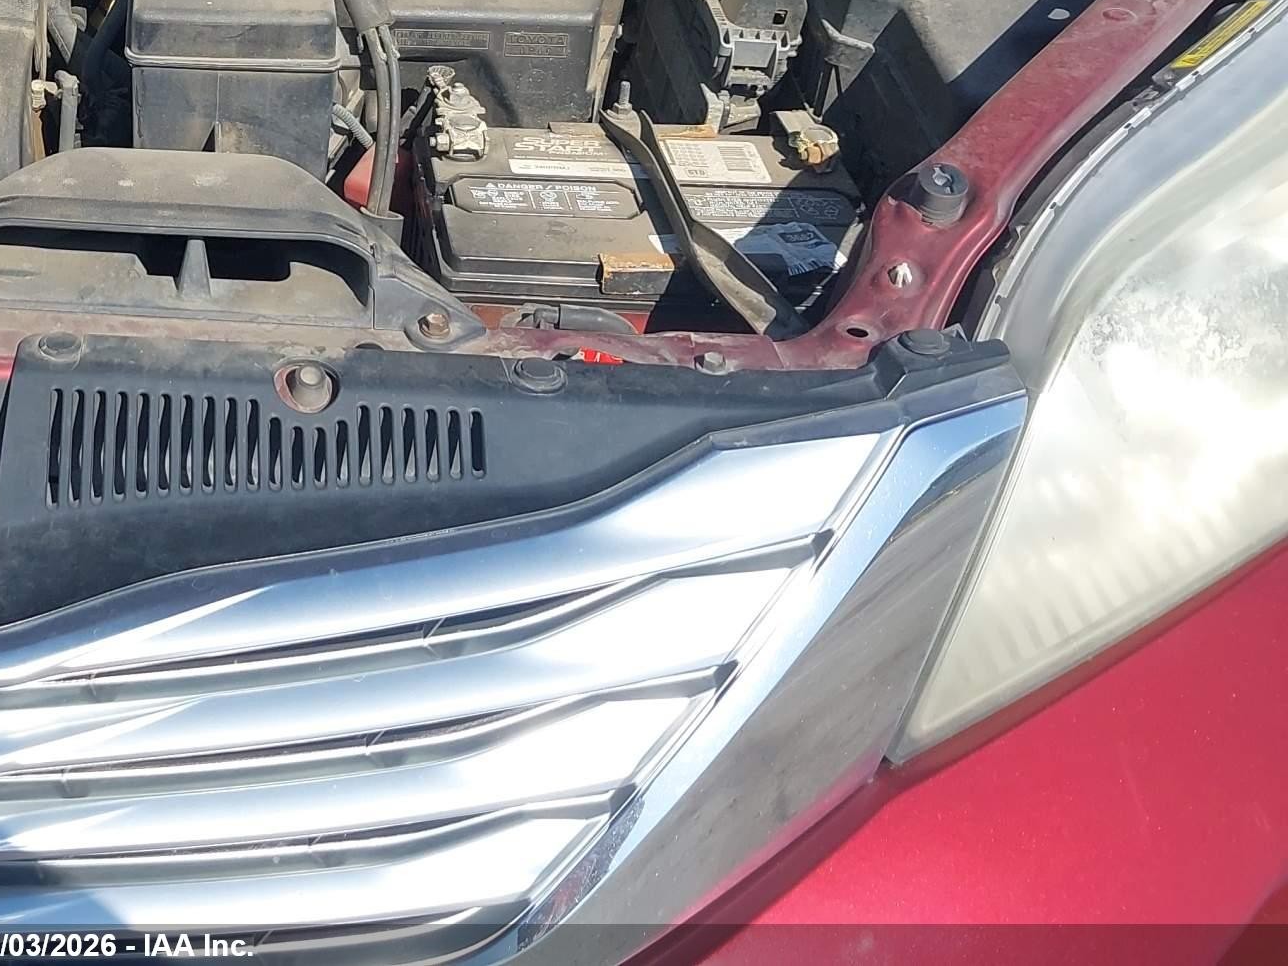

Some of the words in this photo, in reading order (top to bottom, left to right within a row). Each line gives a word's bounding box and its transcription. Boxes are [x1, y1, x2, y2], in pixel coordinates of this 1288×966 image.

[510, 35, 565, 45] TOYOTA
[522, 136, 601, 147] SUPER
[513, 142, 602, 152] START
[497, 183, 544, 191] DANGER
[554, 184, 597, 192] POISON
